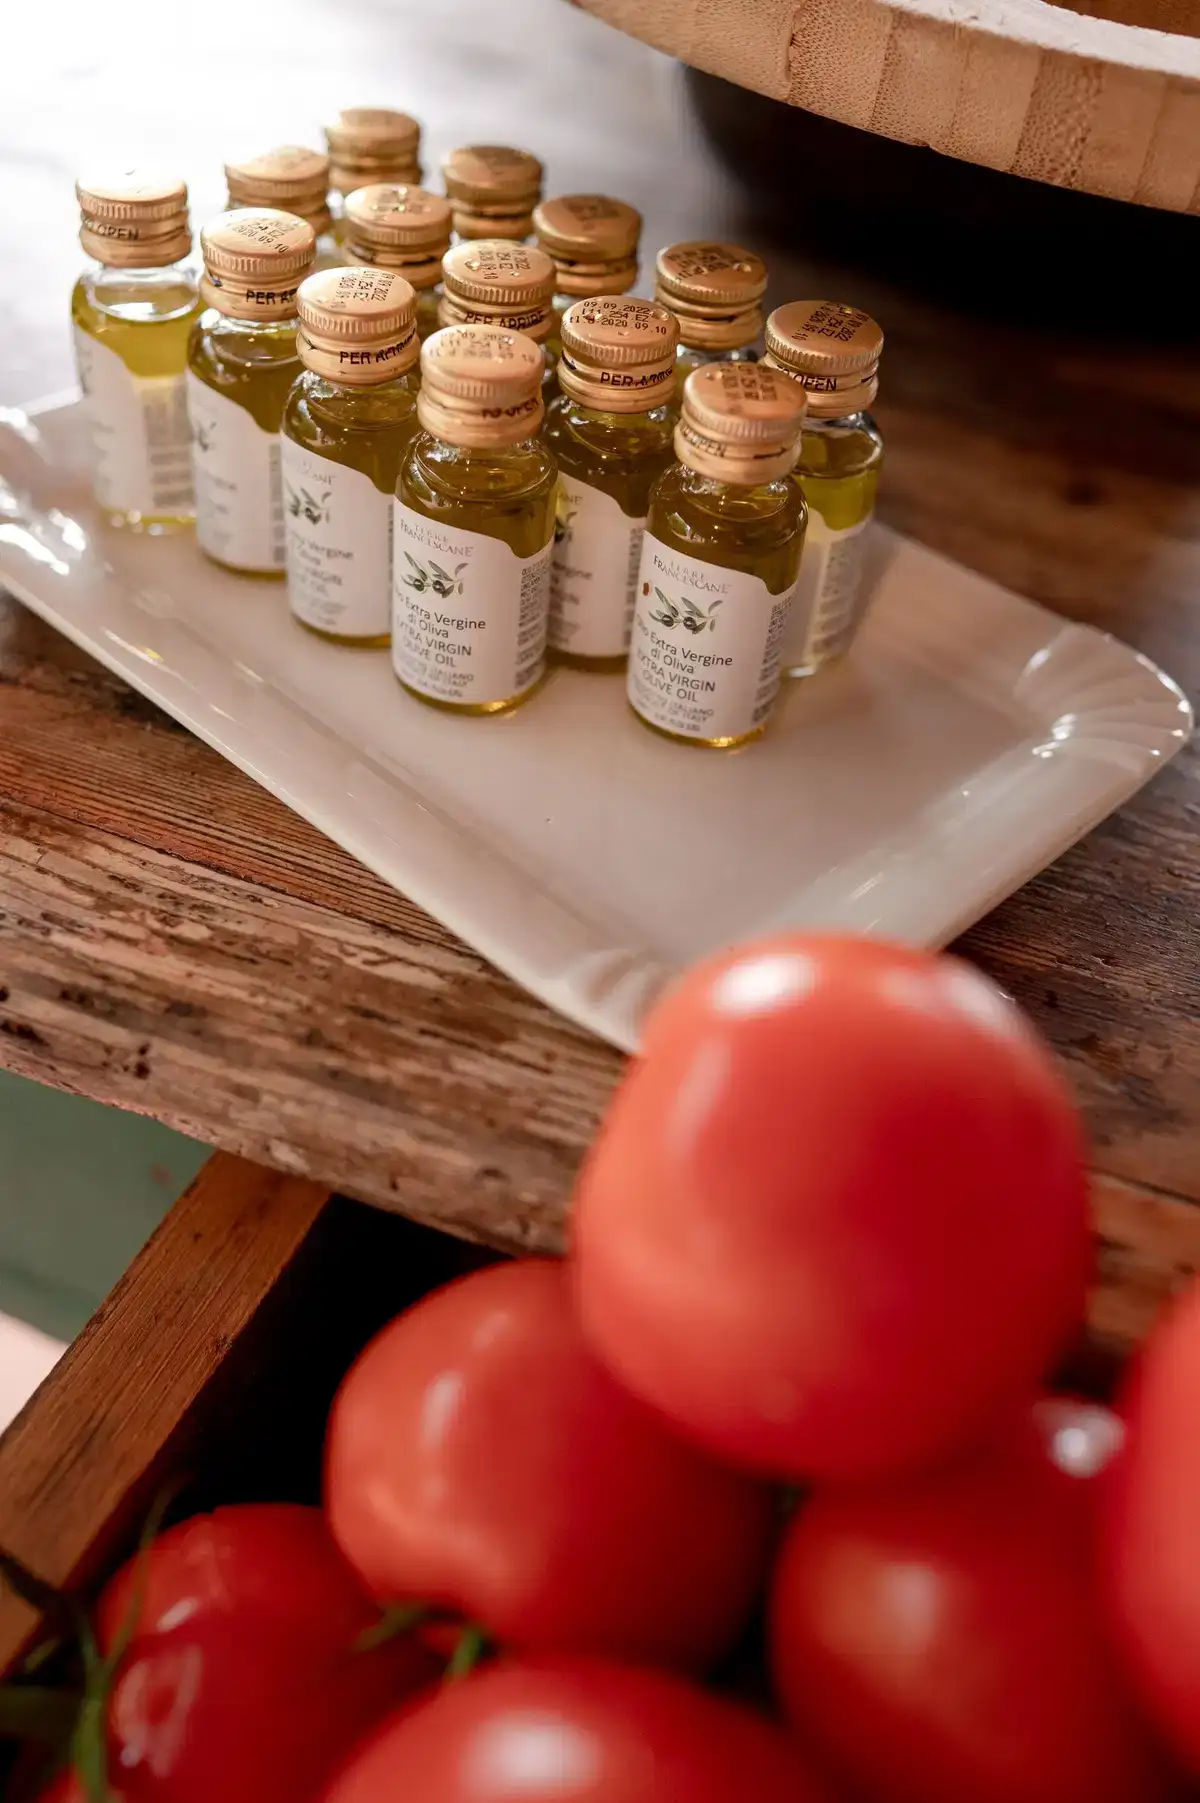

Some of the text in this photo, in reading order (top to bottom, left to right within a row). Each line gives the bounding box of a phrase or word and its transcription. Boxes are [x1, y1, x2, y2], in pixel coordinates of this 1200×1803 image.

[246, 289, 277, 305] PER
[584, 301, 651, 314] 09.09.2022
[339, 350, 371, 365] PER
[600, 371, 633, 392] PER
[400, 518, 475, 557] FRANCESCANE
[653, 554, 731, 594] FRANCESCANE
[405, 596, 486, 631] Extra Vergine
[407, 612, 450, 638] di Oliva
[425, 636, 472, 657] VIRGIN
[650, 631, 678, 656] Extra
[681, 647, 733, 668] Vergine
[435, 653, 457, 668] OIL
[650, 647, 695, 674] di Oliva
[643, 669, 673, 695] OLIVE
[676, 688, 698, 703] OIL
[668, 671, 716, 692] VIRGIN
